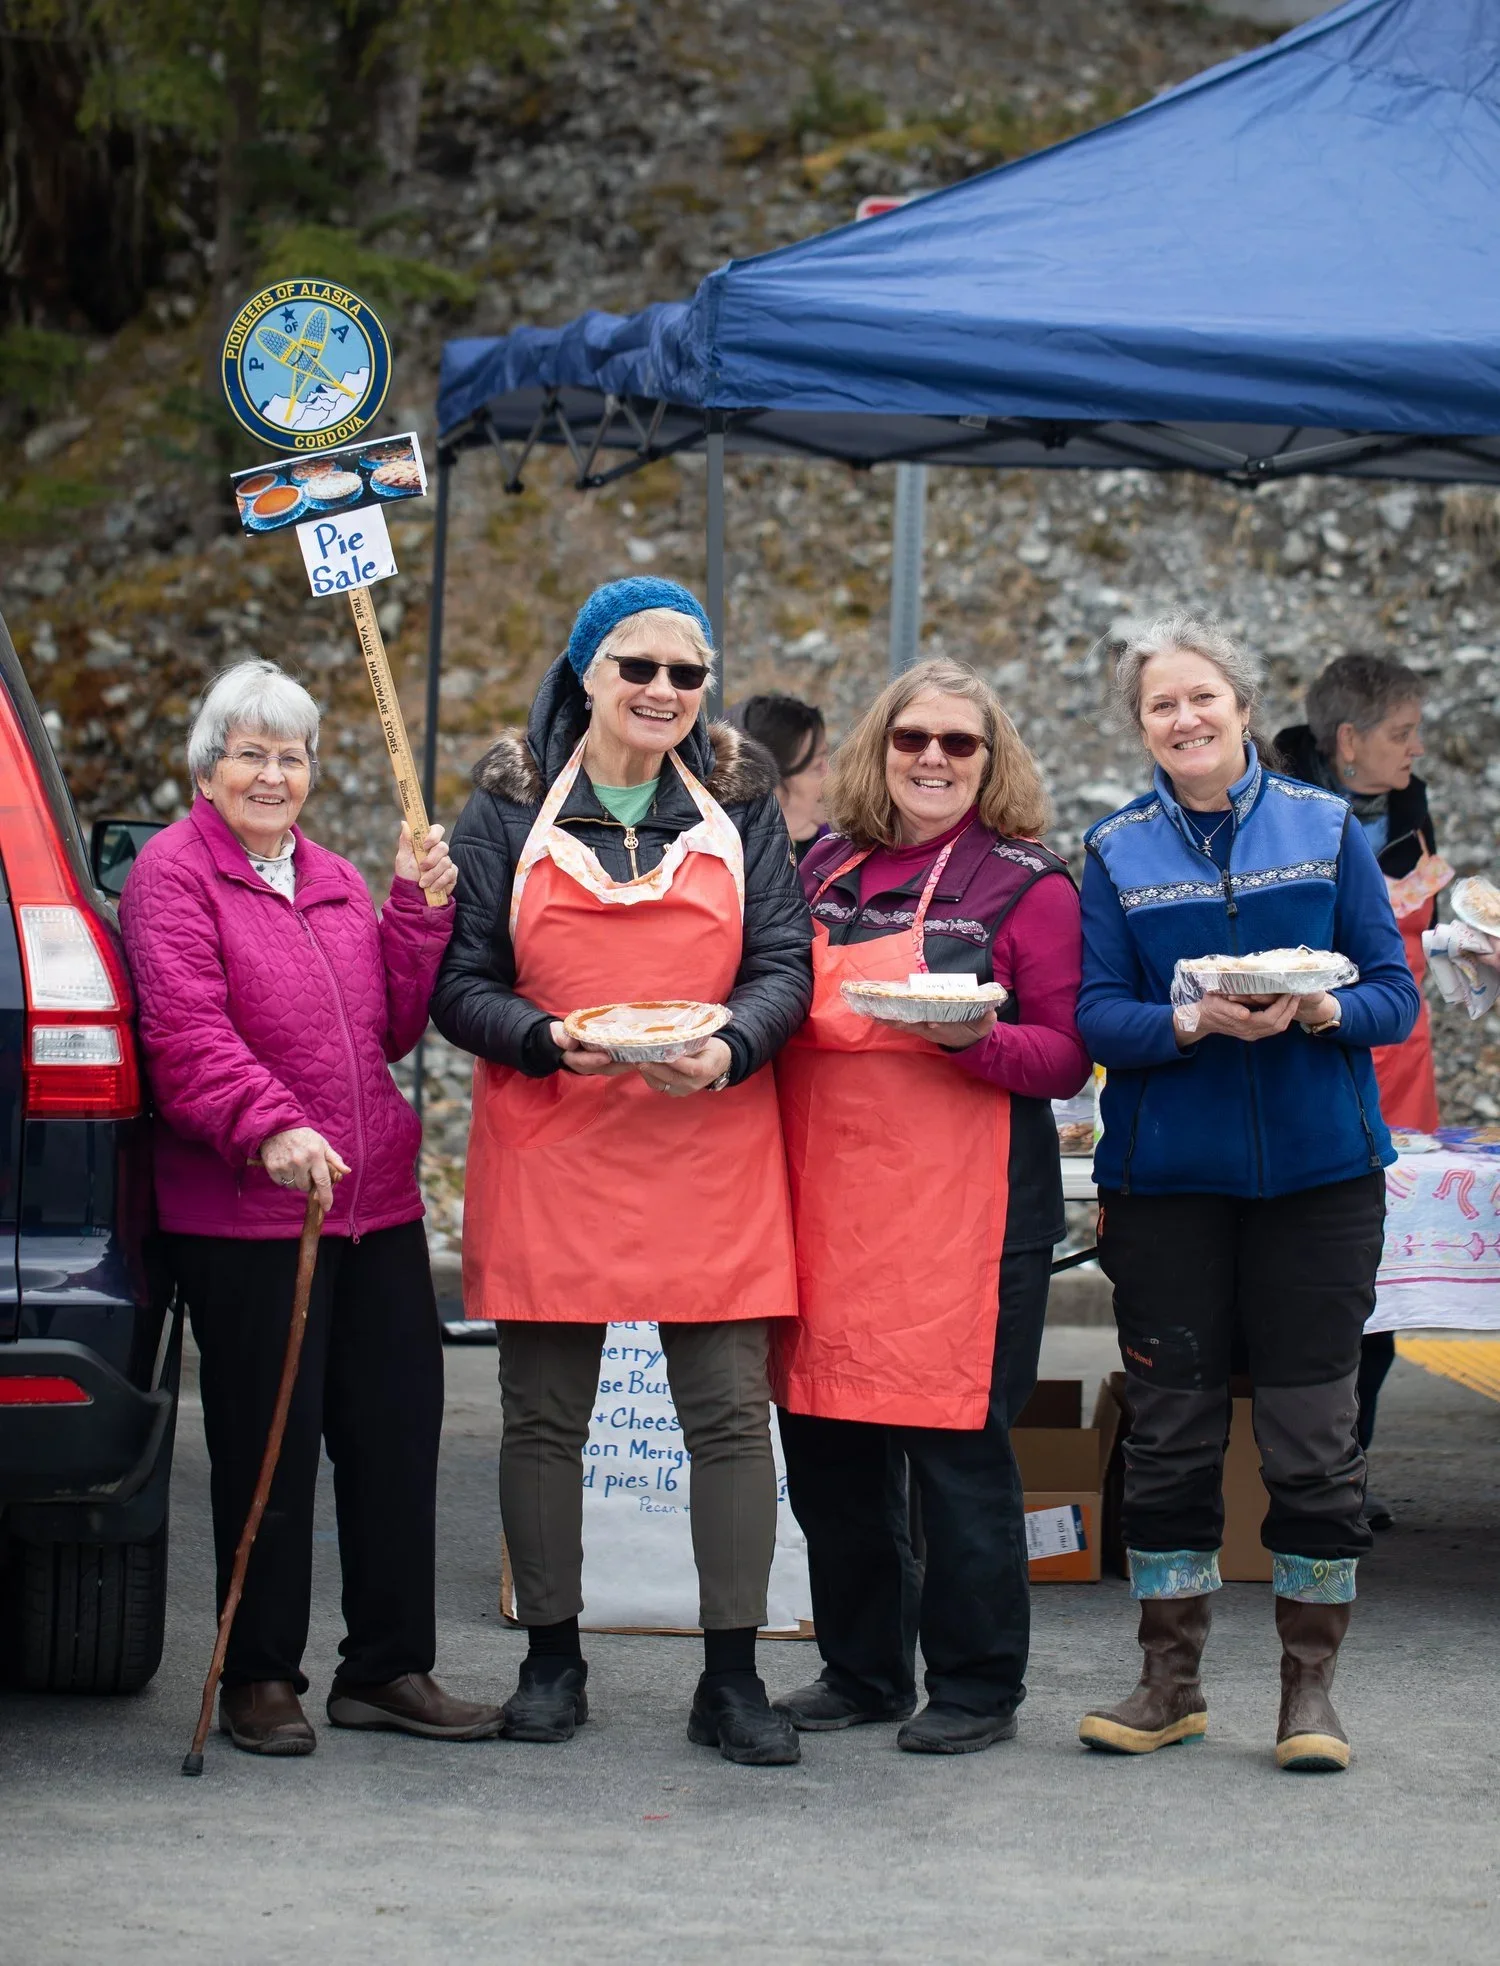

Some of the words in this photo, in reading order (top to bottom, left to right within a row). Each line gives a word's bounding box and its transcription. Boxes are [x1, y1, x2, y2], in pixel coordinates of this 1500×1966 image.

[226, 293, 275, 359] PIONEERS
[275, 284, 295, 299] OF
[300, 283, 362, 316] ALASKA
[249, 357, 264, 371] P
[284, 321, 299, 334] OF
[330, 324, 350, 343] A
[294, 416, 365, 447] CORDOVA
[313, 523, 365, 560] Pie
[312, 555, 380, 594] Sale
[352, 596, 365, 621] TRUE
[359, 624, 374, 657] VALUE
[368, 660, 389, 716] HARDWARE
[384, 720, 400, 754] STORES
[628, 1370, 675, 1404] Bur
[604, 1472, 649, 1498] pies
[656, 1466, 678, 1492] 16
[639, 1495, 678, 1514] Pecan
